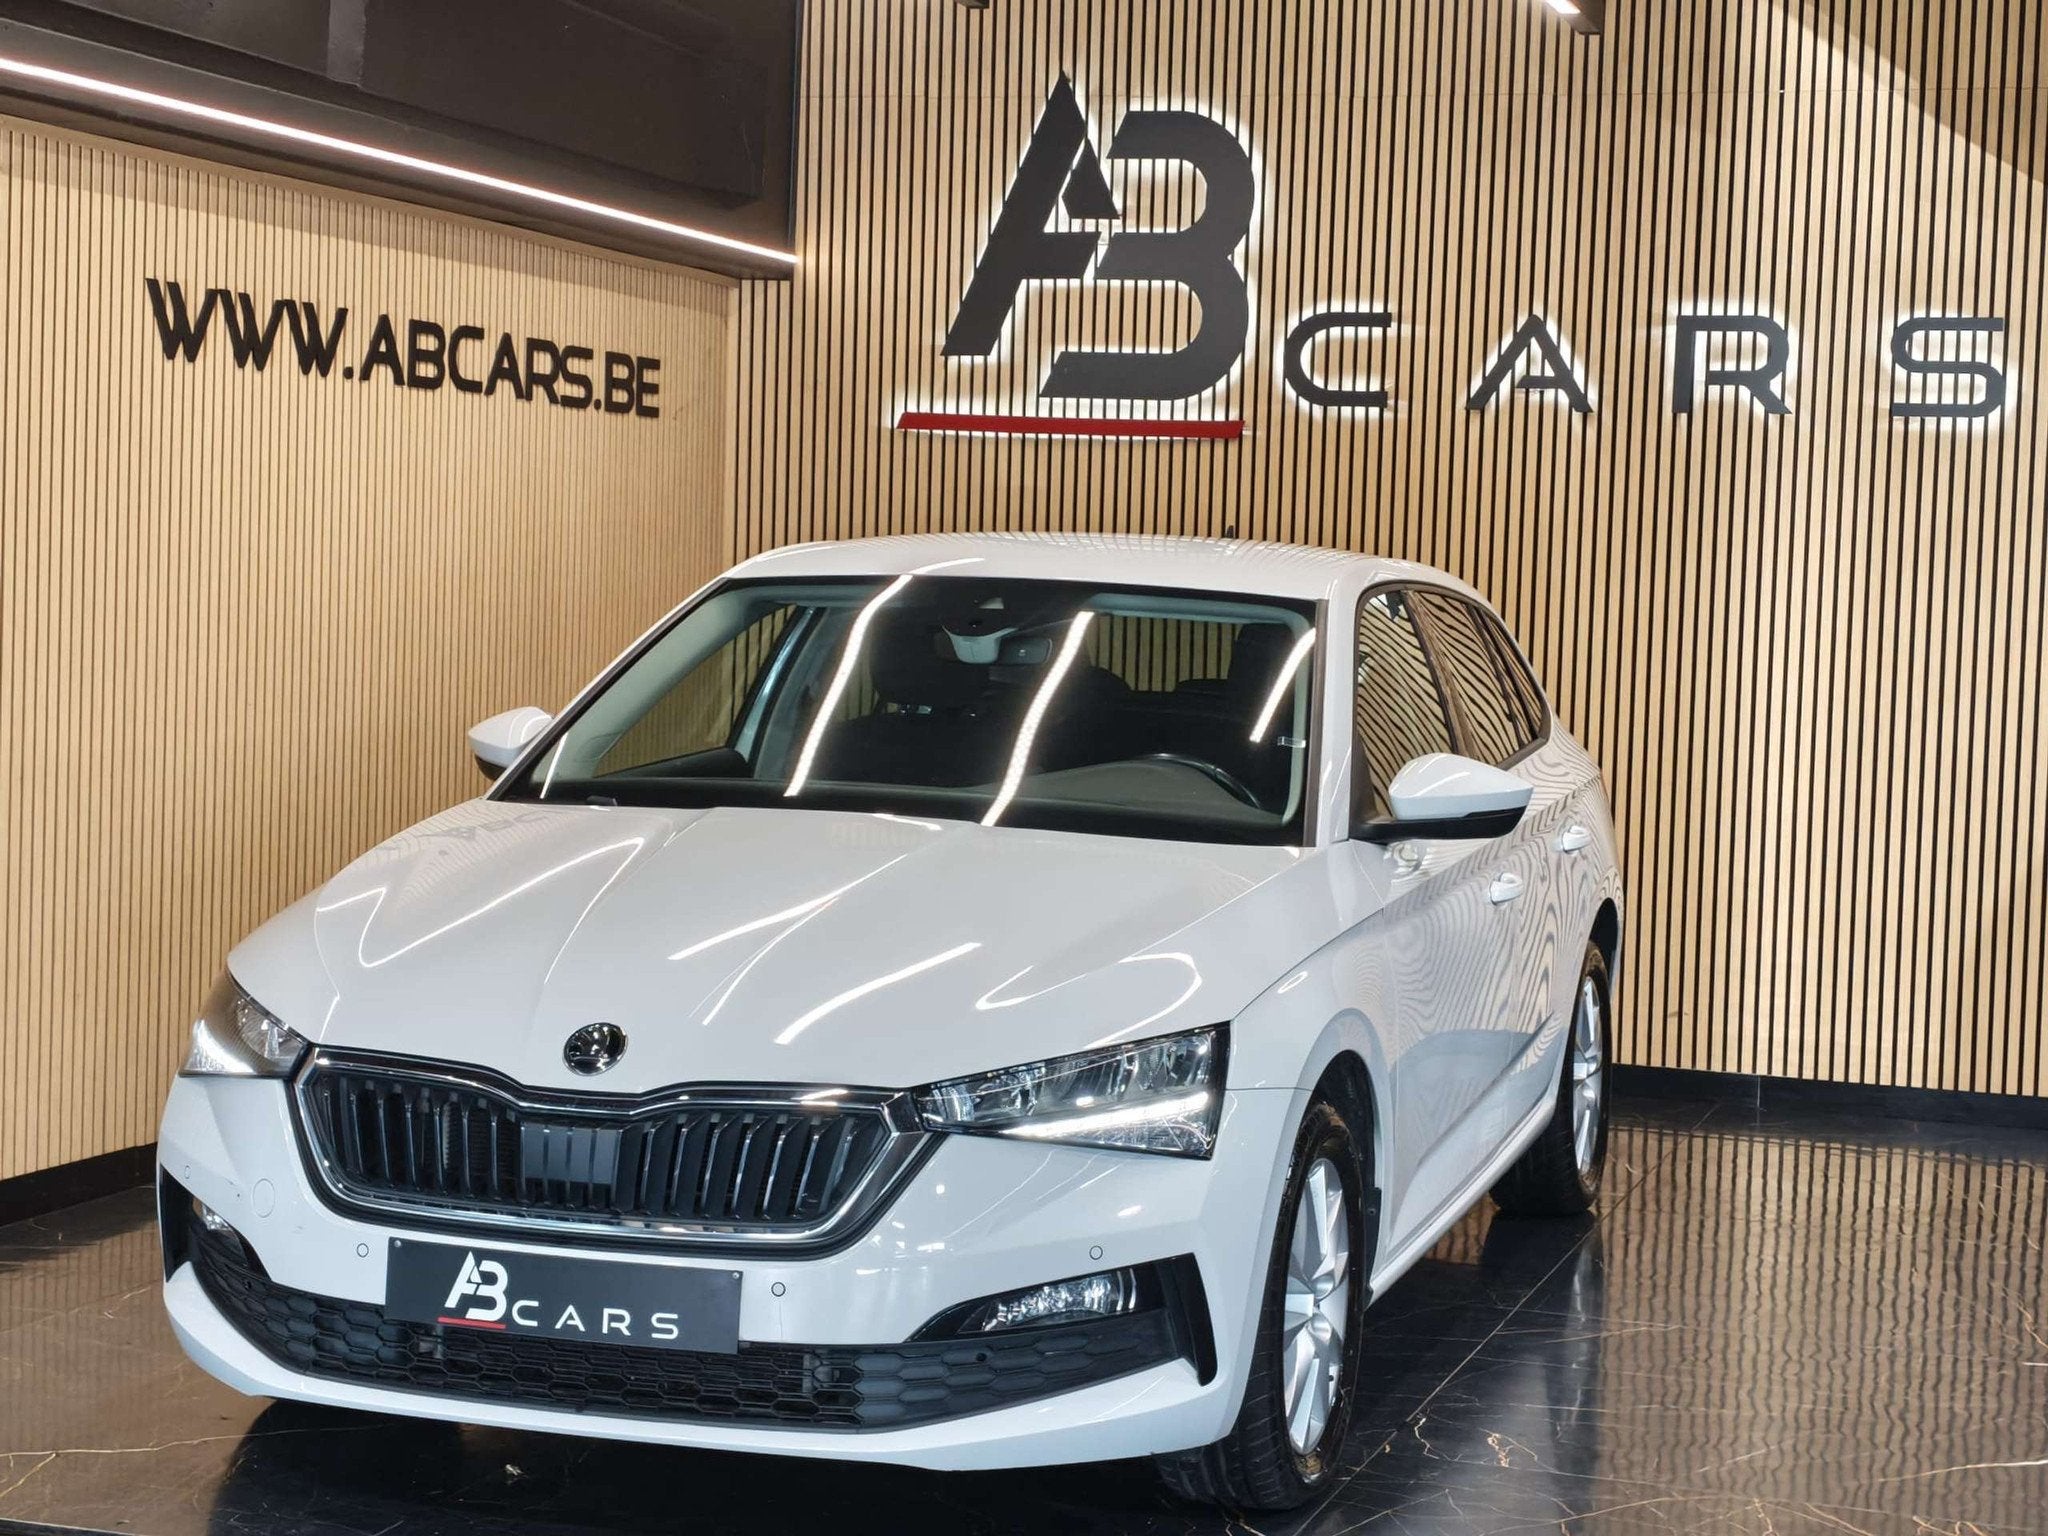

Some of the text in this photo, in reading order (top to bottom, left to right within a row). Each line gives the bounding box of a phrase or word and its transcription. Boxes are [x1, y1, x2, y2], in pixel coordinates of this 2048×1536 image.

[940, 70, 2006, 418] AB CARS
[144, 277, 661, 418] WWW.ABCARS.BE
[444, 1250, 679, 1340] AB CARS
